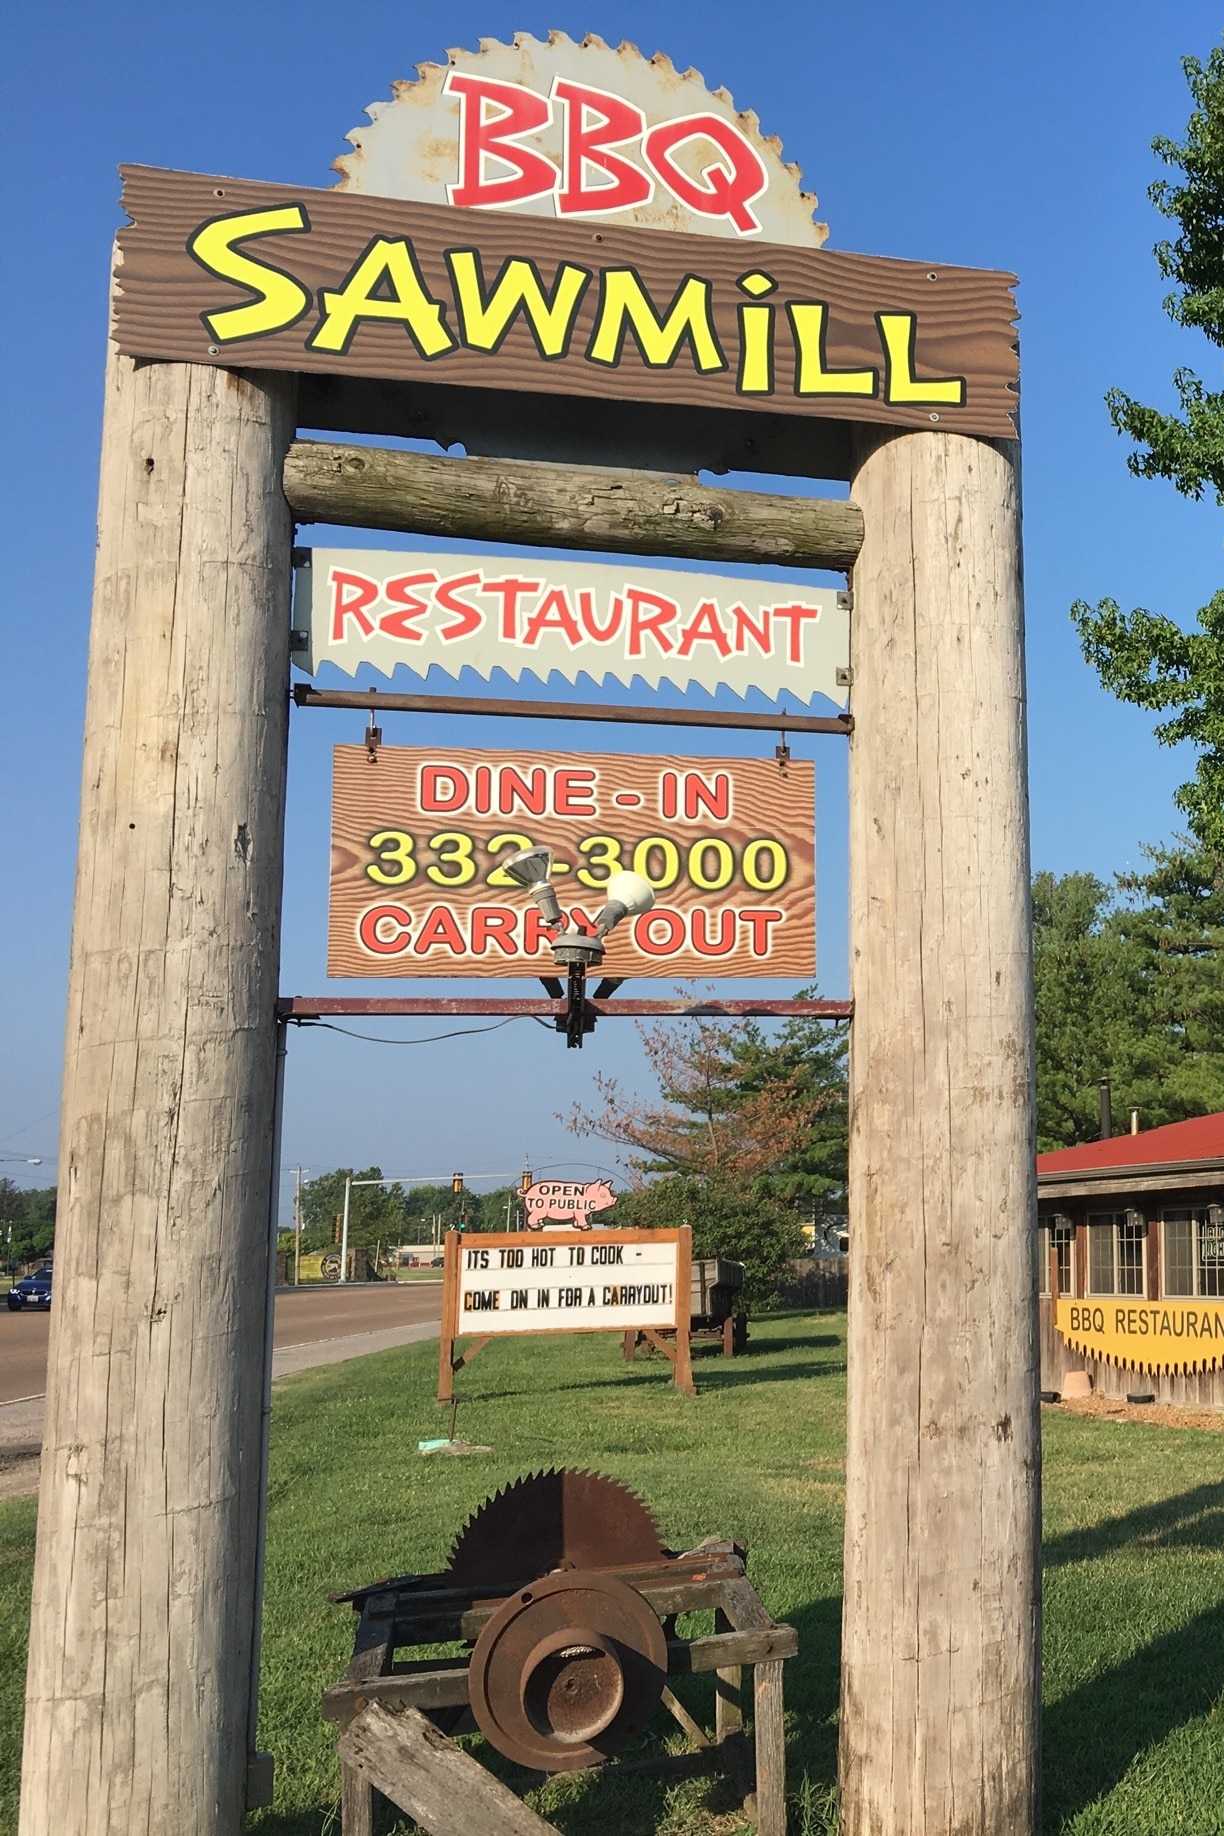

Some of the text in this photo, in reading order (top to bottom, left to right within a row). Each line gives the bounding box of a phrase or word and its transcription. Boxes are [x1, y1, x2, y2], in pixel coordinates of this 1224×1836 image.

[442, 70, 769, 236] BBQ
[328, 564, 822, 666] RESTAURANT
[418, 763, 598, 818] DINE
[660, 769, 732, 823] IN
[364, 829, 790, 891] 332-3000
[632, 906, 784, 958] OUT
[528, 1198, 596, 1210] TO PUBLIC
[539, 1185, 585, 1196] OPEN
[467, 1250, 489, 1269] ITS
[499, 1249, 524, 1268] TOO
[532, 1248, 556, 1267] HOT
[569, 1247, 585, 1265] TO
[591, 1246, 623, 1265] COOK
[464, 1284, 673, 1311] COME ON IN FOR A CARRYOUT!
[1071, 1307, 1105, 1334] BBQ
